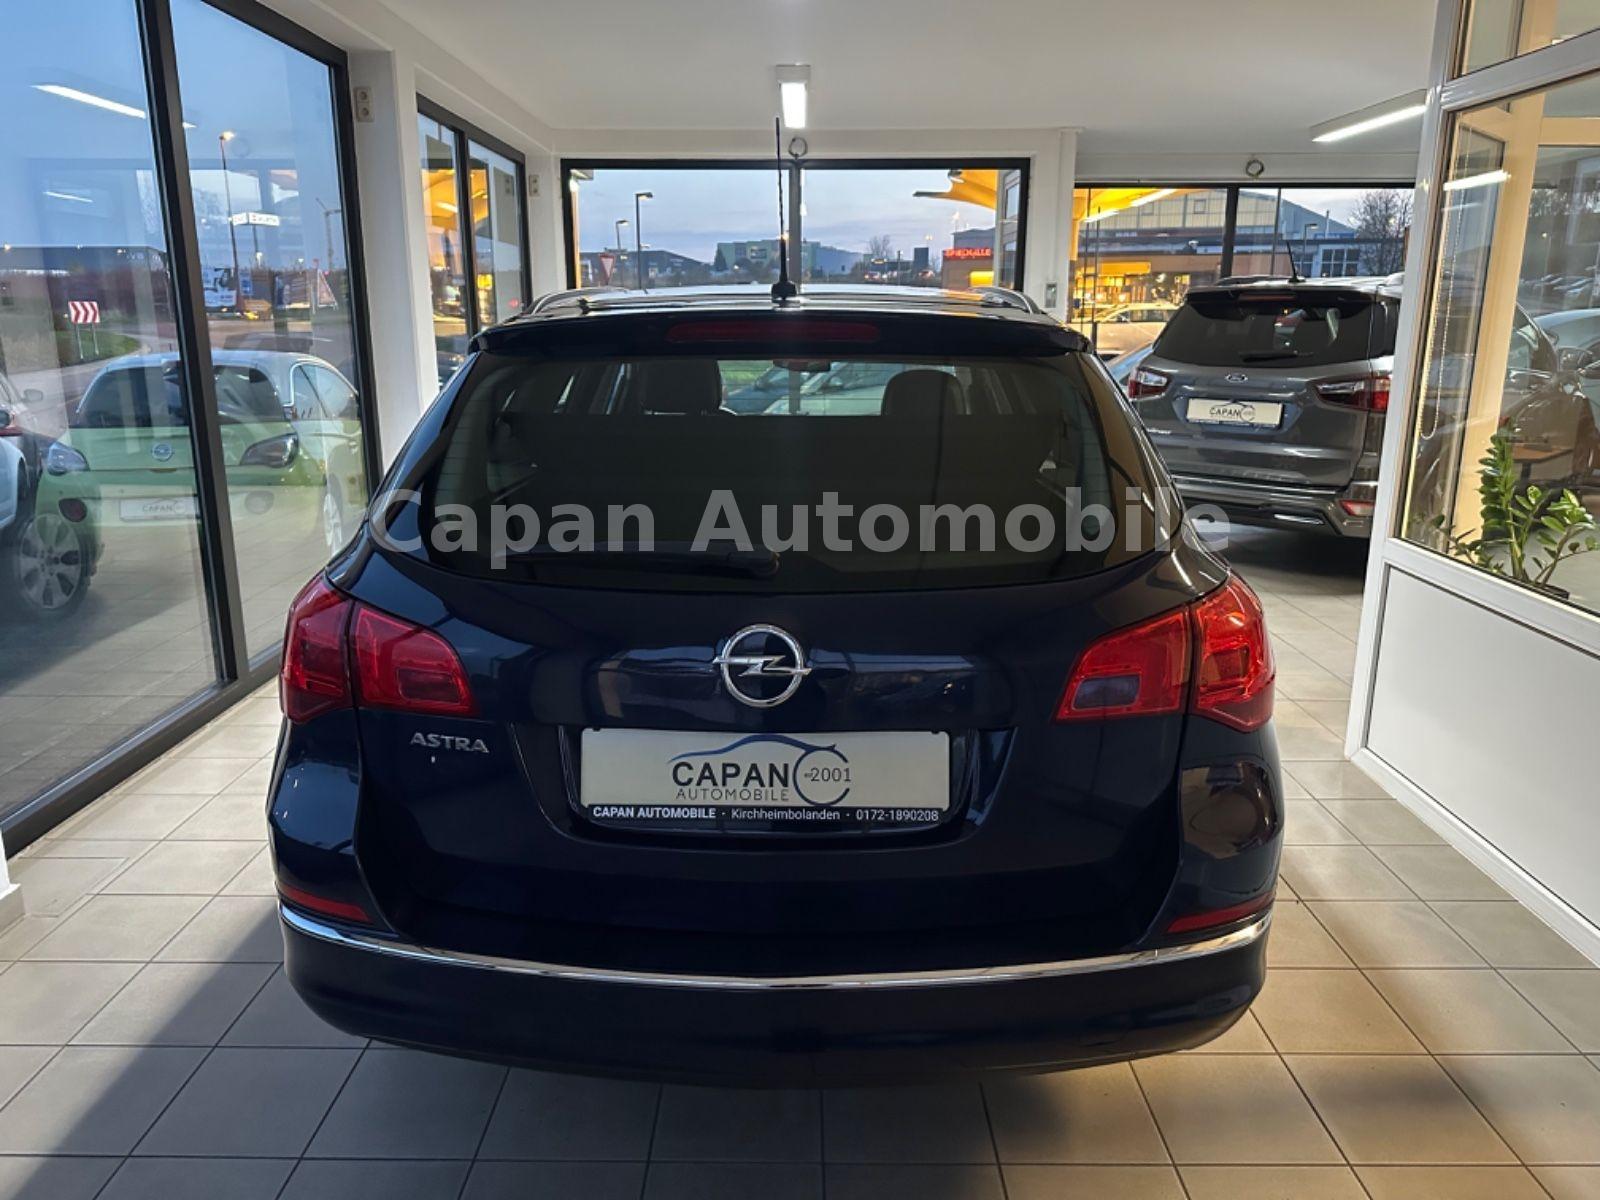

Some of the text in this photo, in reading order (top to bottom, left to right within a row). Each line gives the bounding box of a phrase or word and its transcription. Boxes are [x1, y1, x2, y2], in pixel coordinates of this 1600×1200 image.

[1209, 407, 1241, 417] CAPAN
[410, 731, 490, 753] ASTRA
[672, 761, 852, 788] CAPAN 2001
[675, 788, 790, 802] AUTOMOBILE
[592, 806, 940, 822] CAPAN AUTOMOBILE Kirchheimbolanden 0172-1890208
